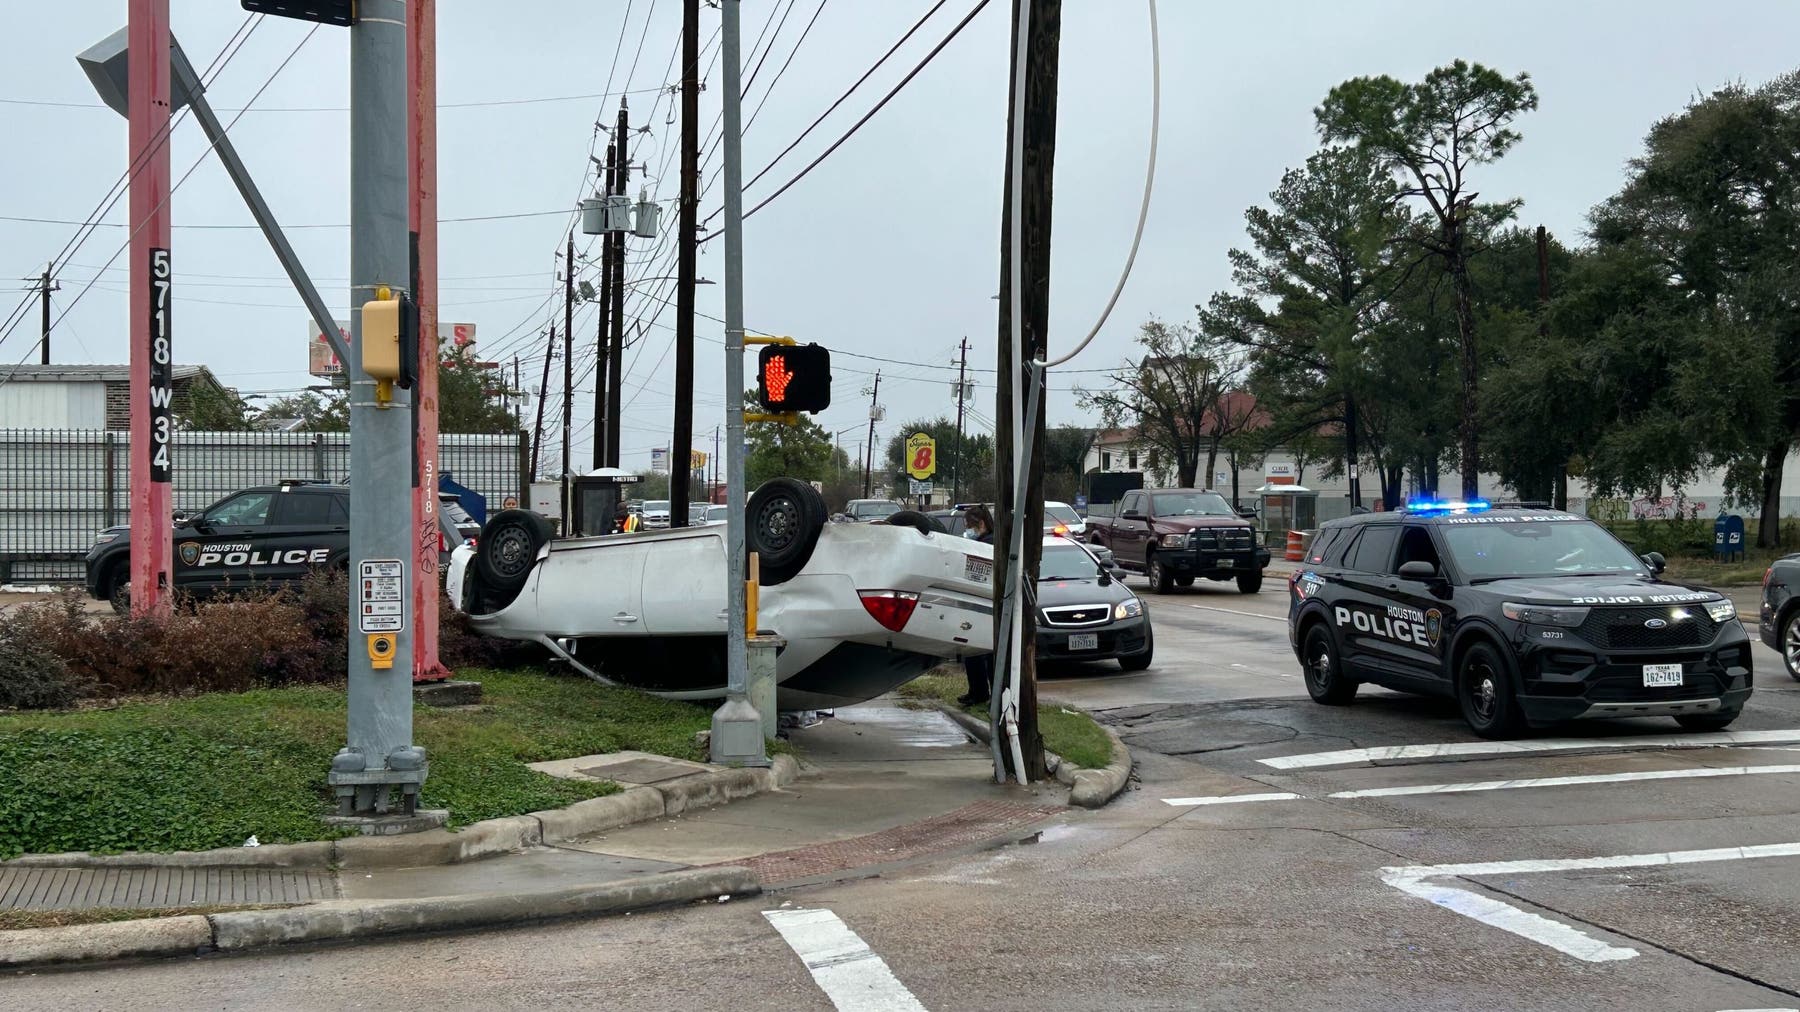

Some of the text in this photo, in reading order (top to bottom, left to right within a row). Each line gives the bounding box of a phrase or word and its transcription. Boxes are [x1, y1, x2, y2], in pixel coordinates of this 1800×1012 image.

[150, 250, 172, 471] 5718 W 34
[912, 447, 932, 470] 8
[425, 460, 433, 513] 5718
[198, 548, 330, 567] POLICE
[203, 543, 251, 552] HOUSTON
[1305, 582, 1318, 595] 911
[1388, 605, 1424, 624] HOUSTON
[1335, 606, 1430, 647] POLICE
